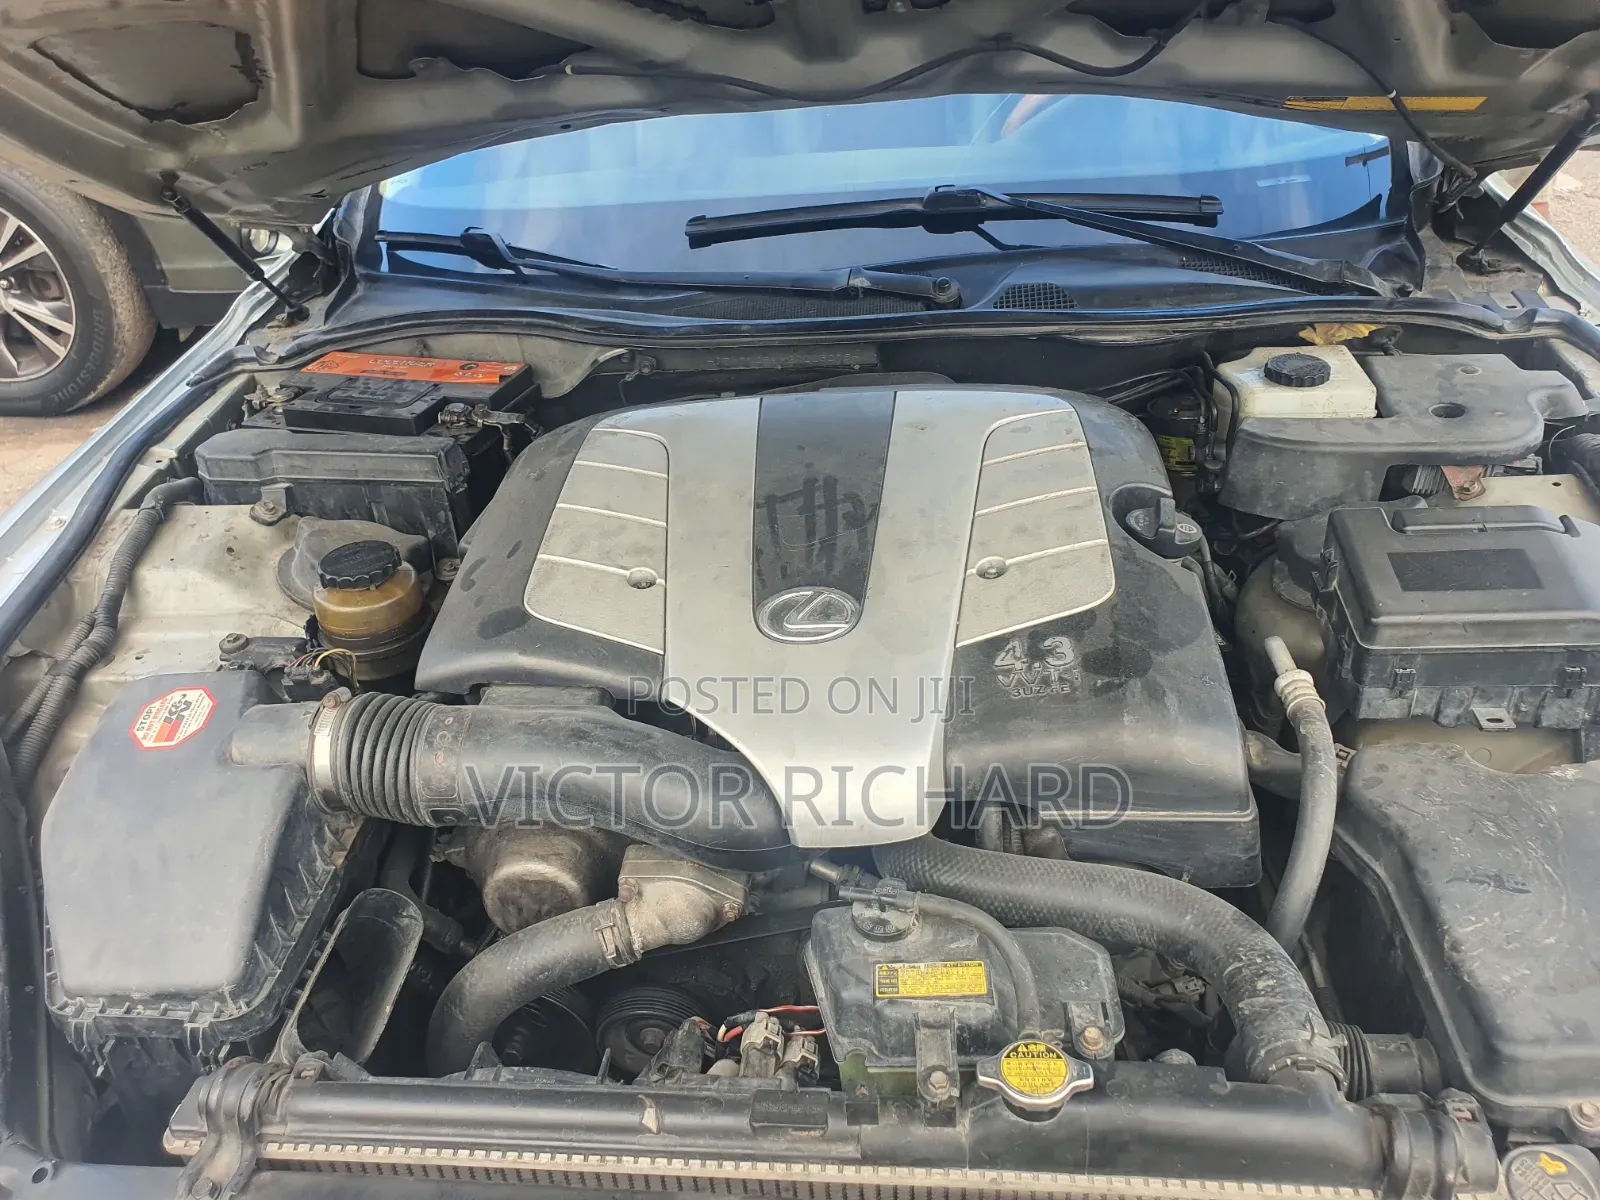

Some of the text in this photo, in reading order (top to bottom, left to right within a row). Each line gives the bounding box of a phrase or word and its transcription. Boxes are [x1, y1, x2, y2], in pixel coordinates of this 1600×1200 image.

[994, 636, 1075, 671] 4.3
[136, 705, 157, 732] STOP!
[1009, 1051, 1057, 1059] CAUTION
